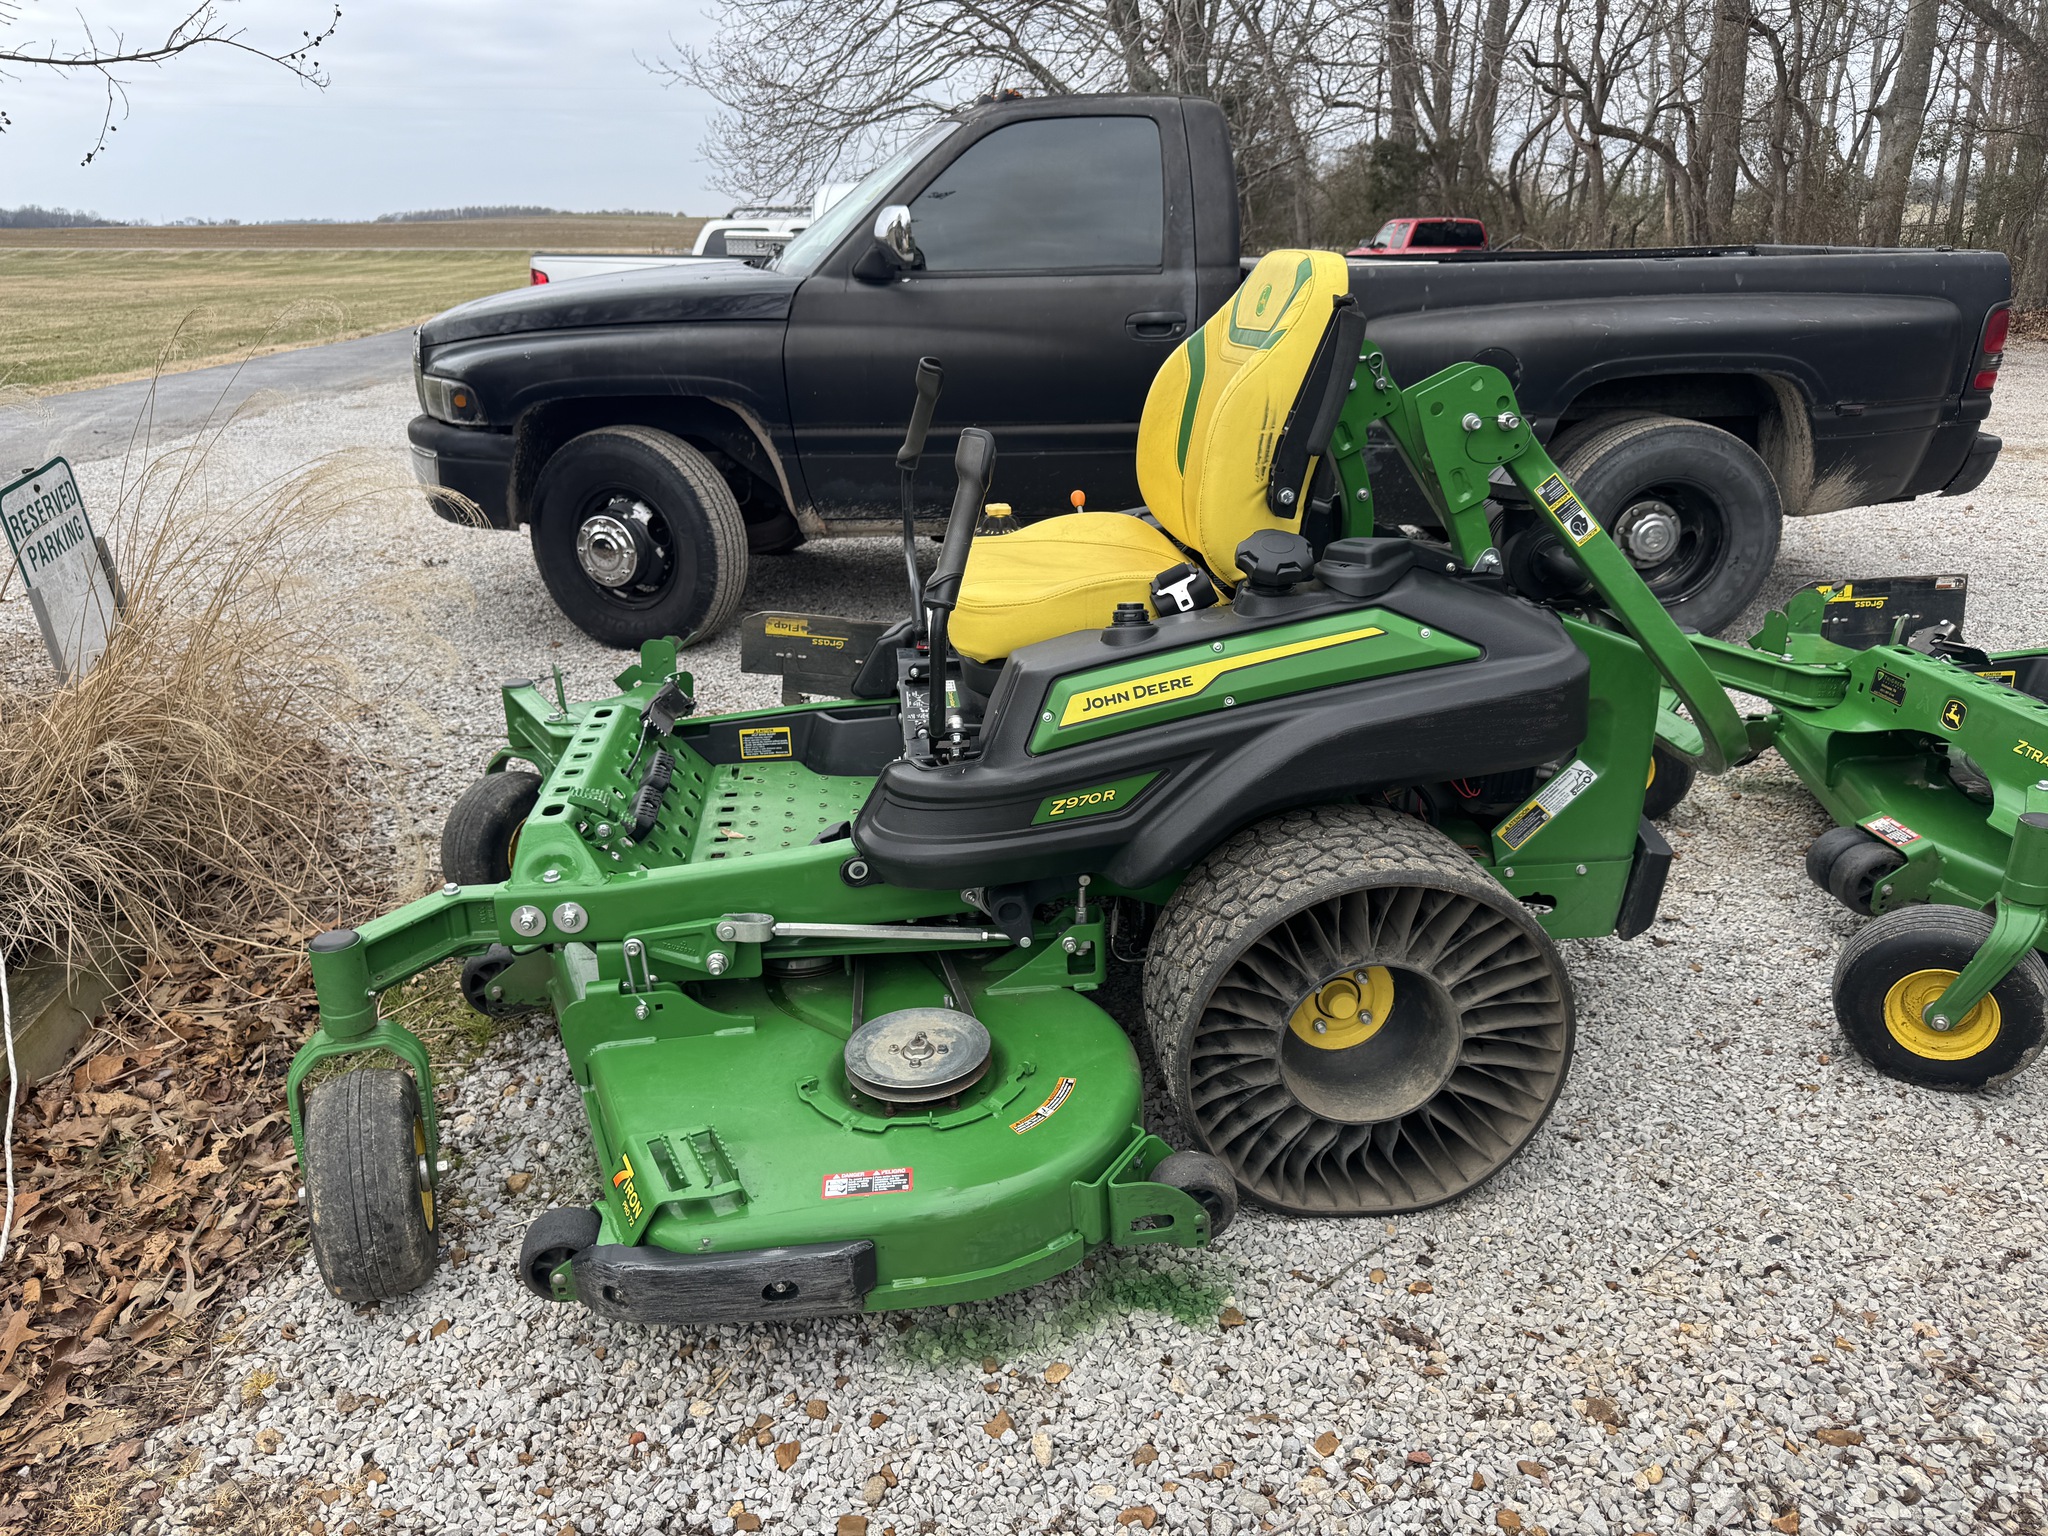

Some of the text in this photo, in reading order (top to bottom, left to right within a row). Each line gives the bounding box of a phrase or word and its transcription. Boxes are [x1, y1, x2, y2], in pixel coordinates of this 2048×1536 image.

[8, 480, 77, 543] RESERVED
[27, 515, 85, 572] PARKING
[1855, 600, 1884, 609] Grass
[774, 621, 799, 632] Flap
[812, 638, 844, 649] Grass
[1082, 675, 1193, 712] JOHN DEERE
[622, 1200, 634, 1228] PRO 72
